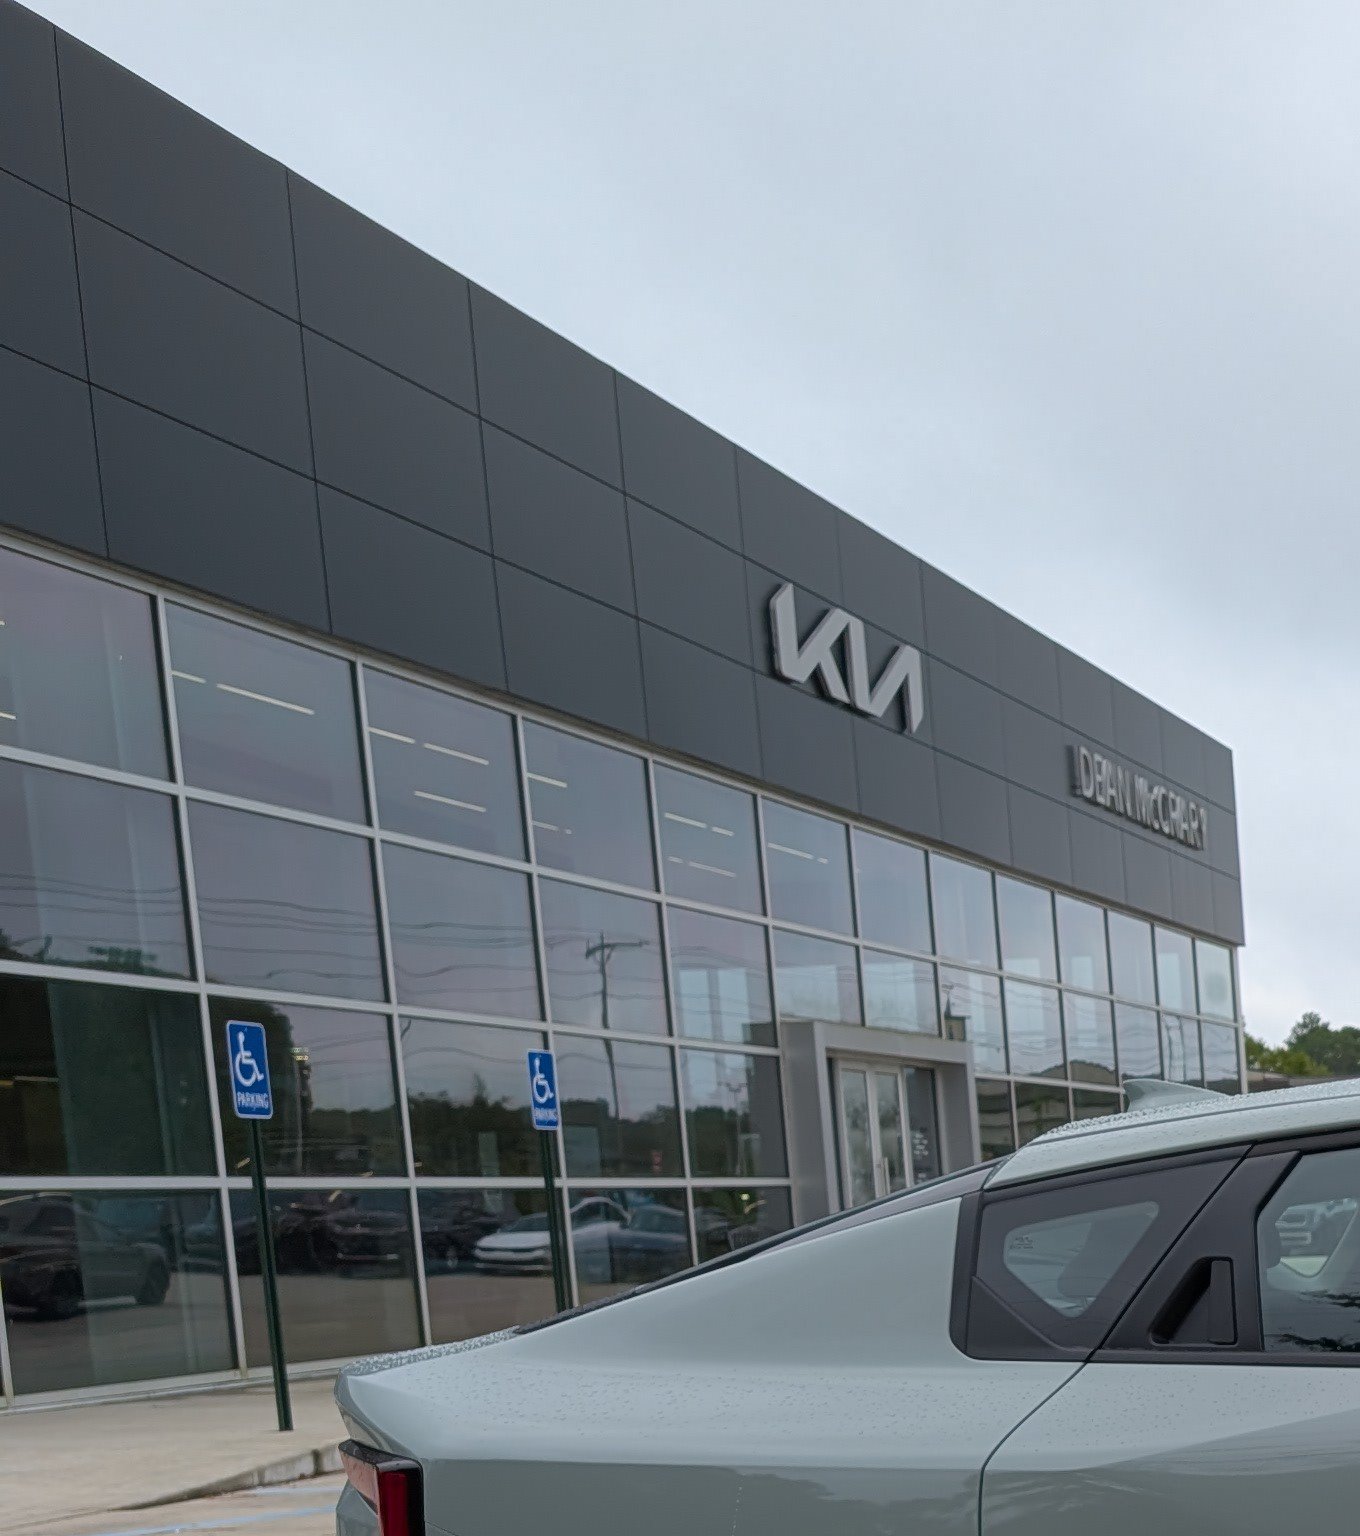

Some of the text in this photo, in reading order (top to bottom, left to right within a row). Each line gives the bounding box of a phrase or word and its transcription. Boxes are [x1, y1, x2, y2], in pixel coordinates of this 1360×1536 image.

[769, 582, 924, 734] KIA
[1073, 745, 1132, 817] DEAN
[237, 1091, 269, 1109] PARKING
[534, 1107, 557, 1121] PARKING
